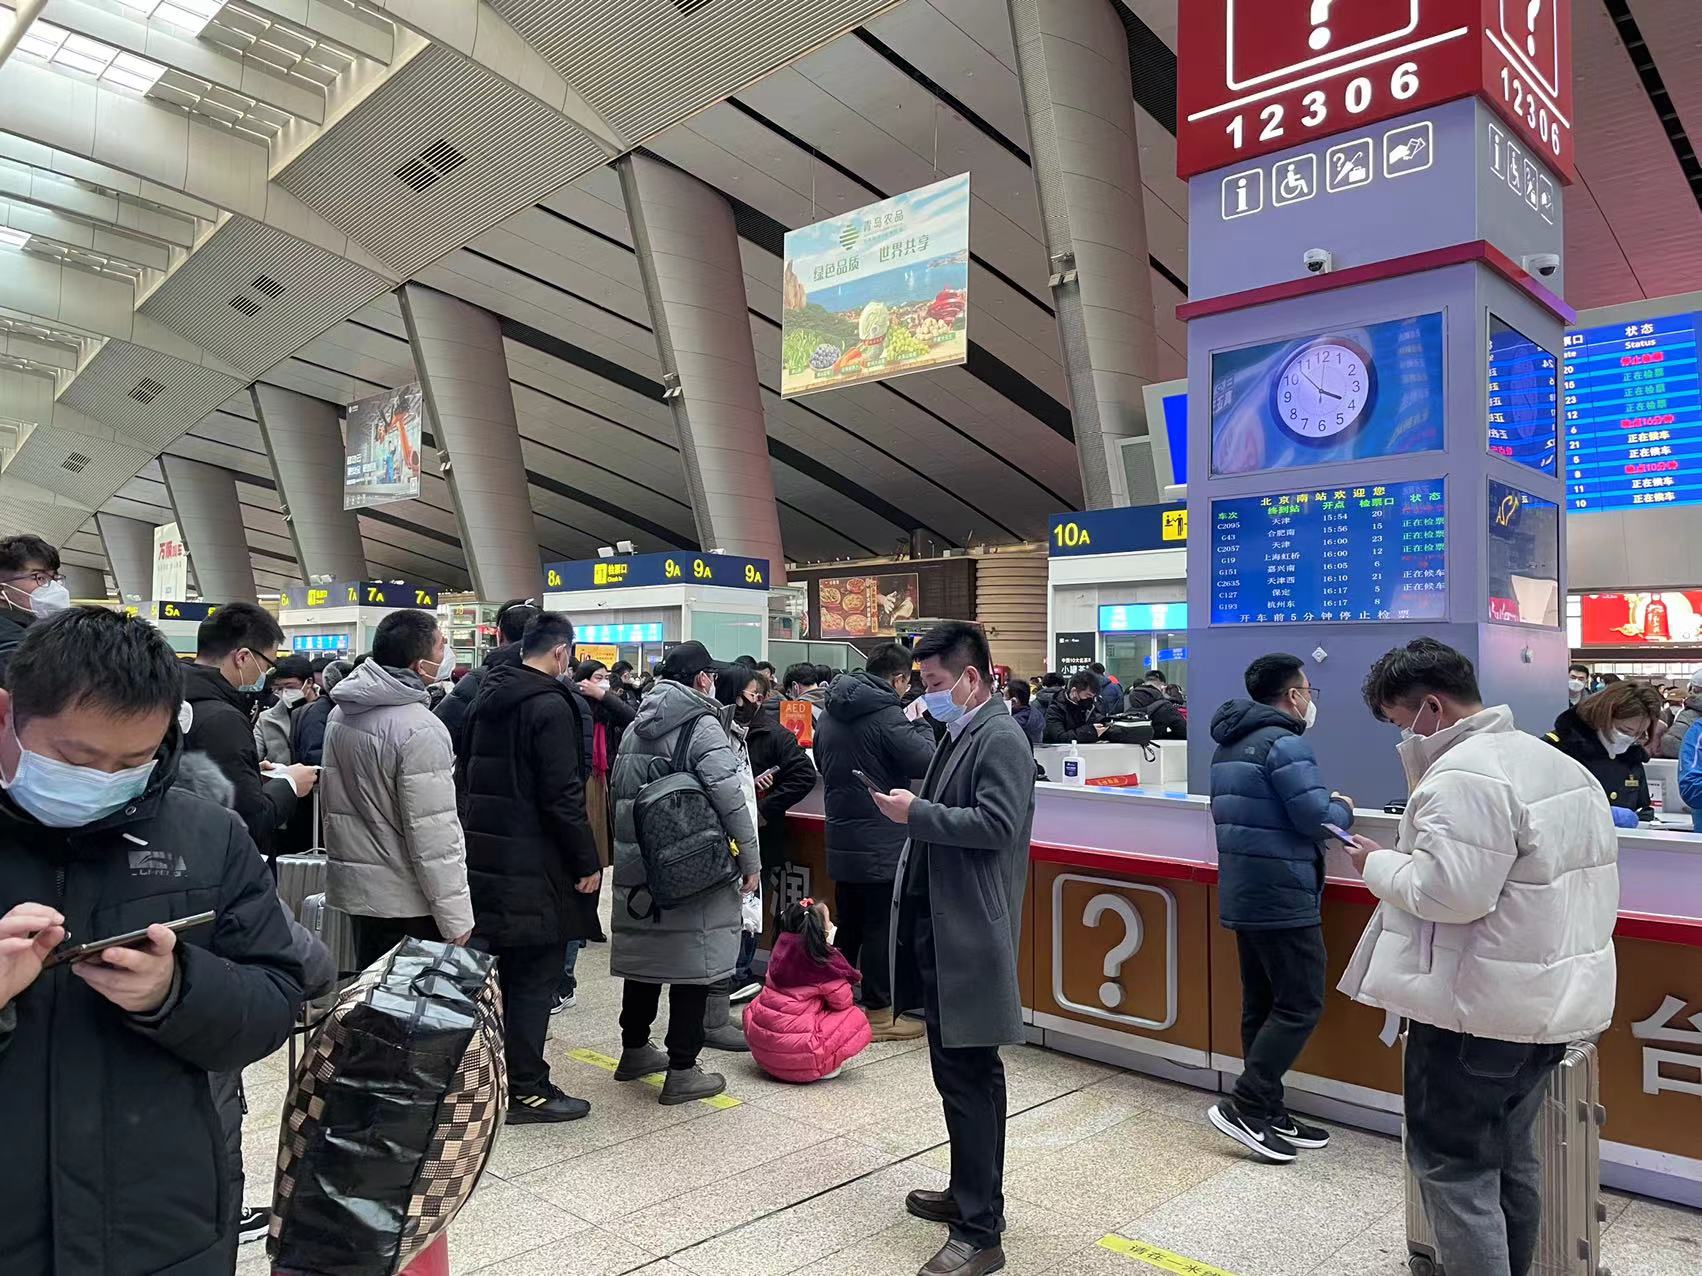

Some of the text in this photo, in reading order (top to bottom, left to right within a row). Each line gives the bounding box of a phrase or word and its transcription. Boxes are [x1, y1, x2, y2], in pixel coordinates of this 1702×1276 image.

[1226, 62, 1420, 149] 12306
[1501, 66, 1561, 155] 12306
[813, 234, 929, 282] 绿色品质 世界共享
[1624, 323, 1654, 337] 状态
[1624, 338, 1657, 350] Status
[1314, 351, 1330, 363] 12
[1336, 352, 1342, 364] 1
[1347, 364, 1356, 376] 2
[1283, 373, 1299, 386] 10
[1352, 380, 1361, 393] 3
[1283, 391, 1292, 403] 9
[1565, 395, 1577, 405] 23
[1347, 399, 1356, 411] 4
[1289, 408, 1298, 420] 8
[1335, 413, 1344, 425] 5
[1567, 410, 1579, 420] 12
[1301, 418, 1309, 430] 7
[1318, 419, 1327, 432] 6
[1570, 425, 1578, 434] 6
[1569, 440, 1581, 450] 21
[1574, 484, 1585, 494] 11
[1260, 486, 1386, 506] 北京南站欢迎您
[1217, 511, 1238, 520] 车次
[1322, 500, 1345, 510] 开点
[1359, 497, 1395, 508] 检票口
[1409, 492, 1441, 503] 状态
[1575, 499, 1588, 508] 10
[1271, 517, 1291, 526] 天津
[1323, 513, 1348, 521] 15:54
[1371, 510, 1383, 518] 20
[1053, 522, 1091, 547] 10A
[1267, 528, 1296, 538] 合肥南
[1323, 525, 1348, 534] 15:56
[1372, 522, 1383, 530] 15
[1271, 540, 1291, 549] 天津
[1323, 537, 1348, 546] 16:00
[1371, 535, 1383, 543] 23
[1264, 552, 1301, 561] 上海虹桥
[1323, 550, 1348, 558] 16:00
[1372, 547, 1383, 555] 12
[664, 559, 681, 578] 9A
[693, 559, 712, 579] 9A
[1323, 562, 1348, 570] 16:05
[547, 569, 561, 587] 8A
[745, 564, 763, 584] 9A
[1323, 575, 1348, 583] 16:10
[347, 587, 357, 601] 7A
[367, 587, 385, 602] 7A
[414, 590, 432, 605] 7A
[1271, 588, 1291, 597] 保定
[1323, 587, 1348, 595] 16:17
[1374, 585, 1381, 593] 5
[164, 604, 181, 617] 5A
[1267, 600, 1296, 609] 杭州东
[1323, 599, 1348, 607] 16:17
[1239, 609, 1412, 623] 开车前5分钟停止检票
[785, 703, 806, 713] AED
